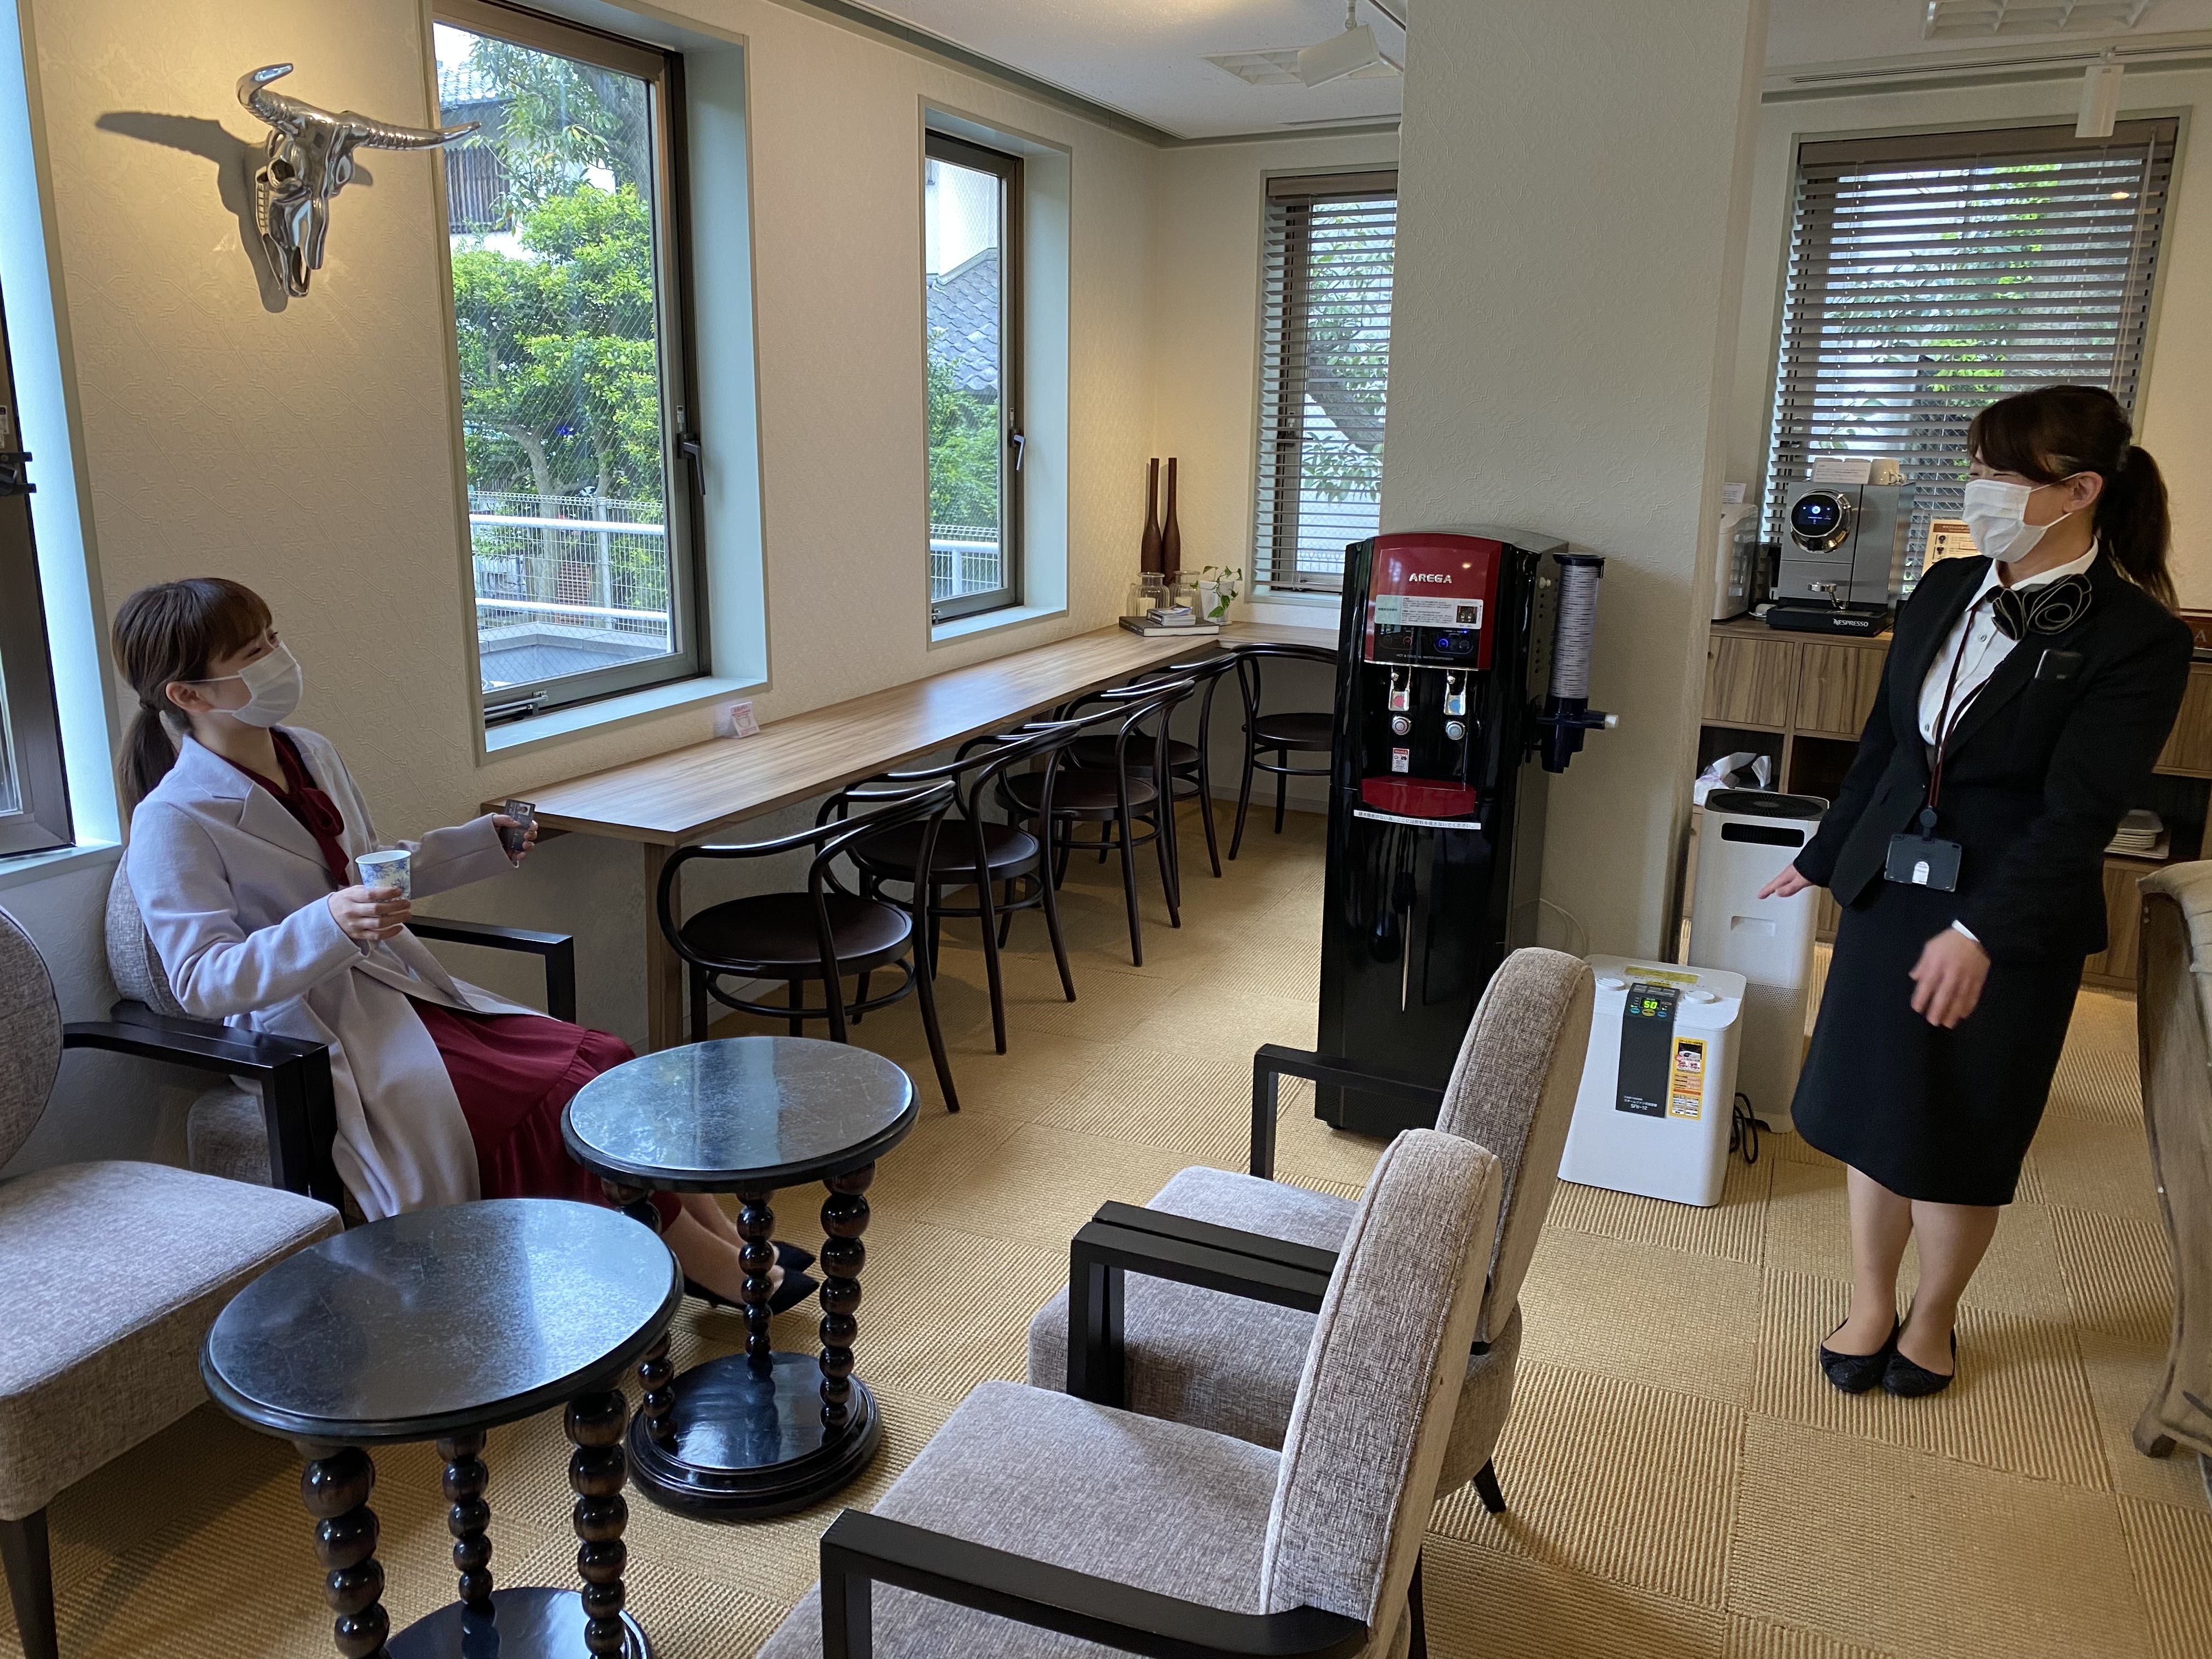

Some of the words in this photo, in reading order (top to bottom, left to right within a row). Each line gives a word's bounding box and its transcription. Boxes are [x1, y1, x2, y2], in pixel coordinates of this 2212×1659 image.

[1409, 573, 1452, 584] AREGA
[1832, 618, 1869, 627] NESPRESSO
[1644, 1000, 1657, 1009] 50
